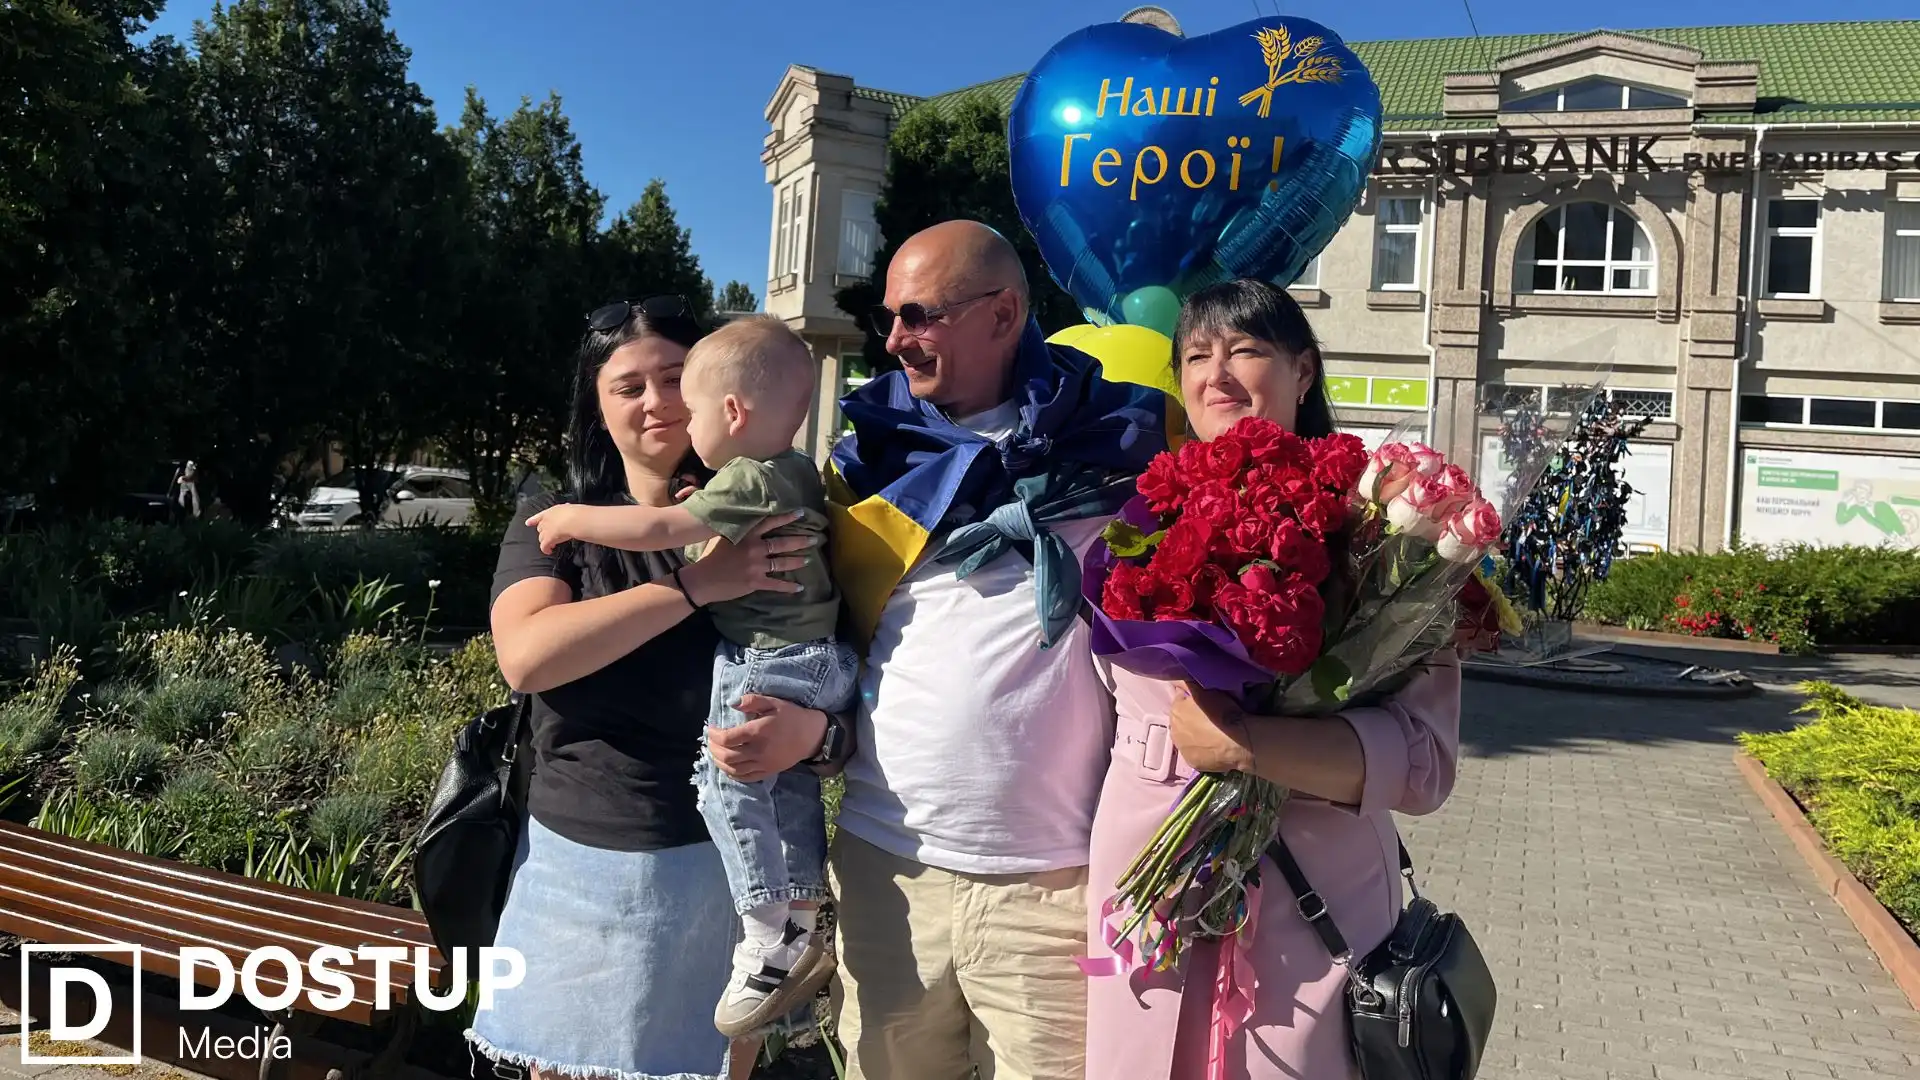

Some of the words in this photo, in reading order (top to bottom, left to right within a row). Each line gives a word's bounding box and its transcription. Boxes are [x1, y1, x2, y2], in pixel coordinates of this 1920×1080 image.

[1095, 76, 1219, 118] Наші
[1683, 152, 1749, 171] BNP
[1760, 151, 1902, 171] PARIBAS
